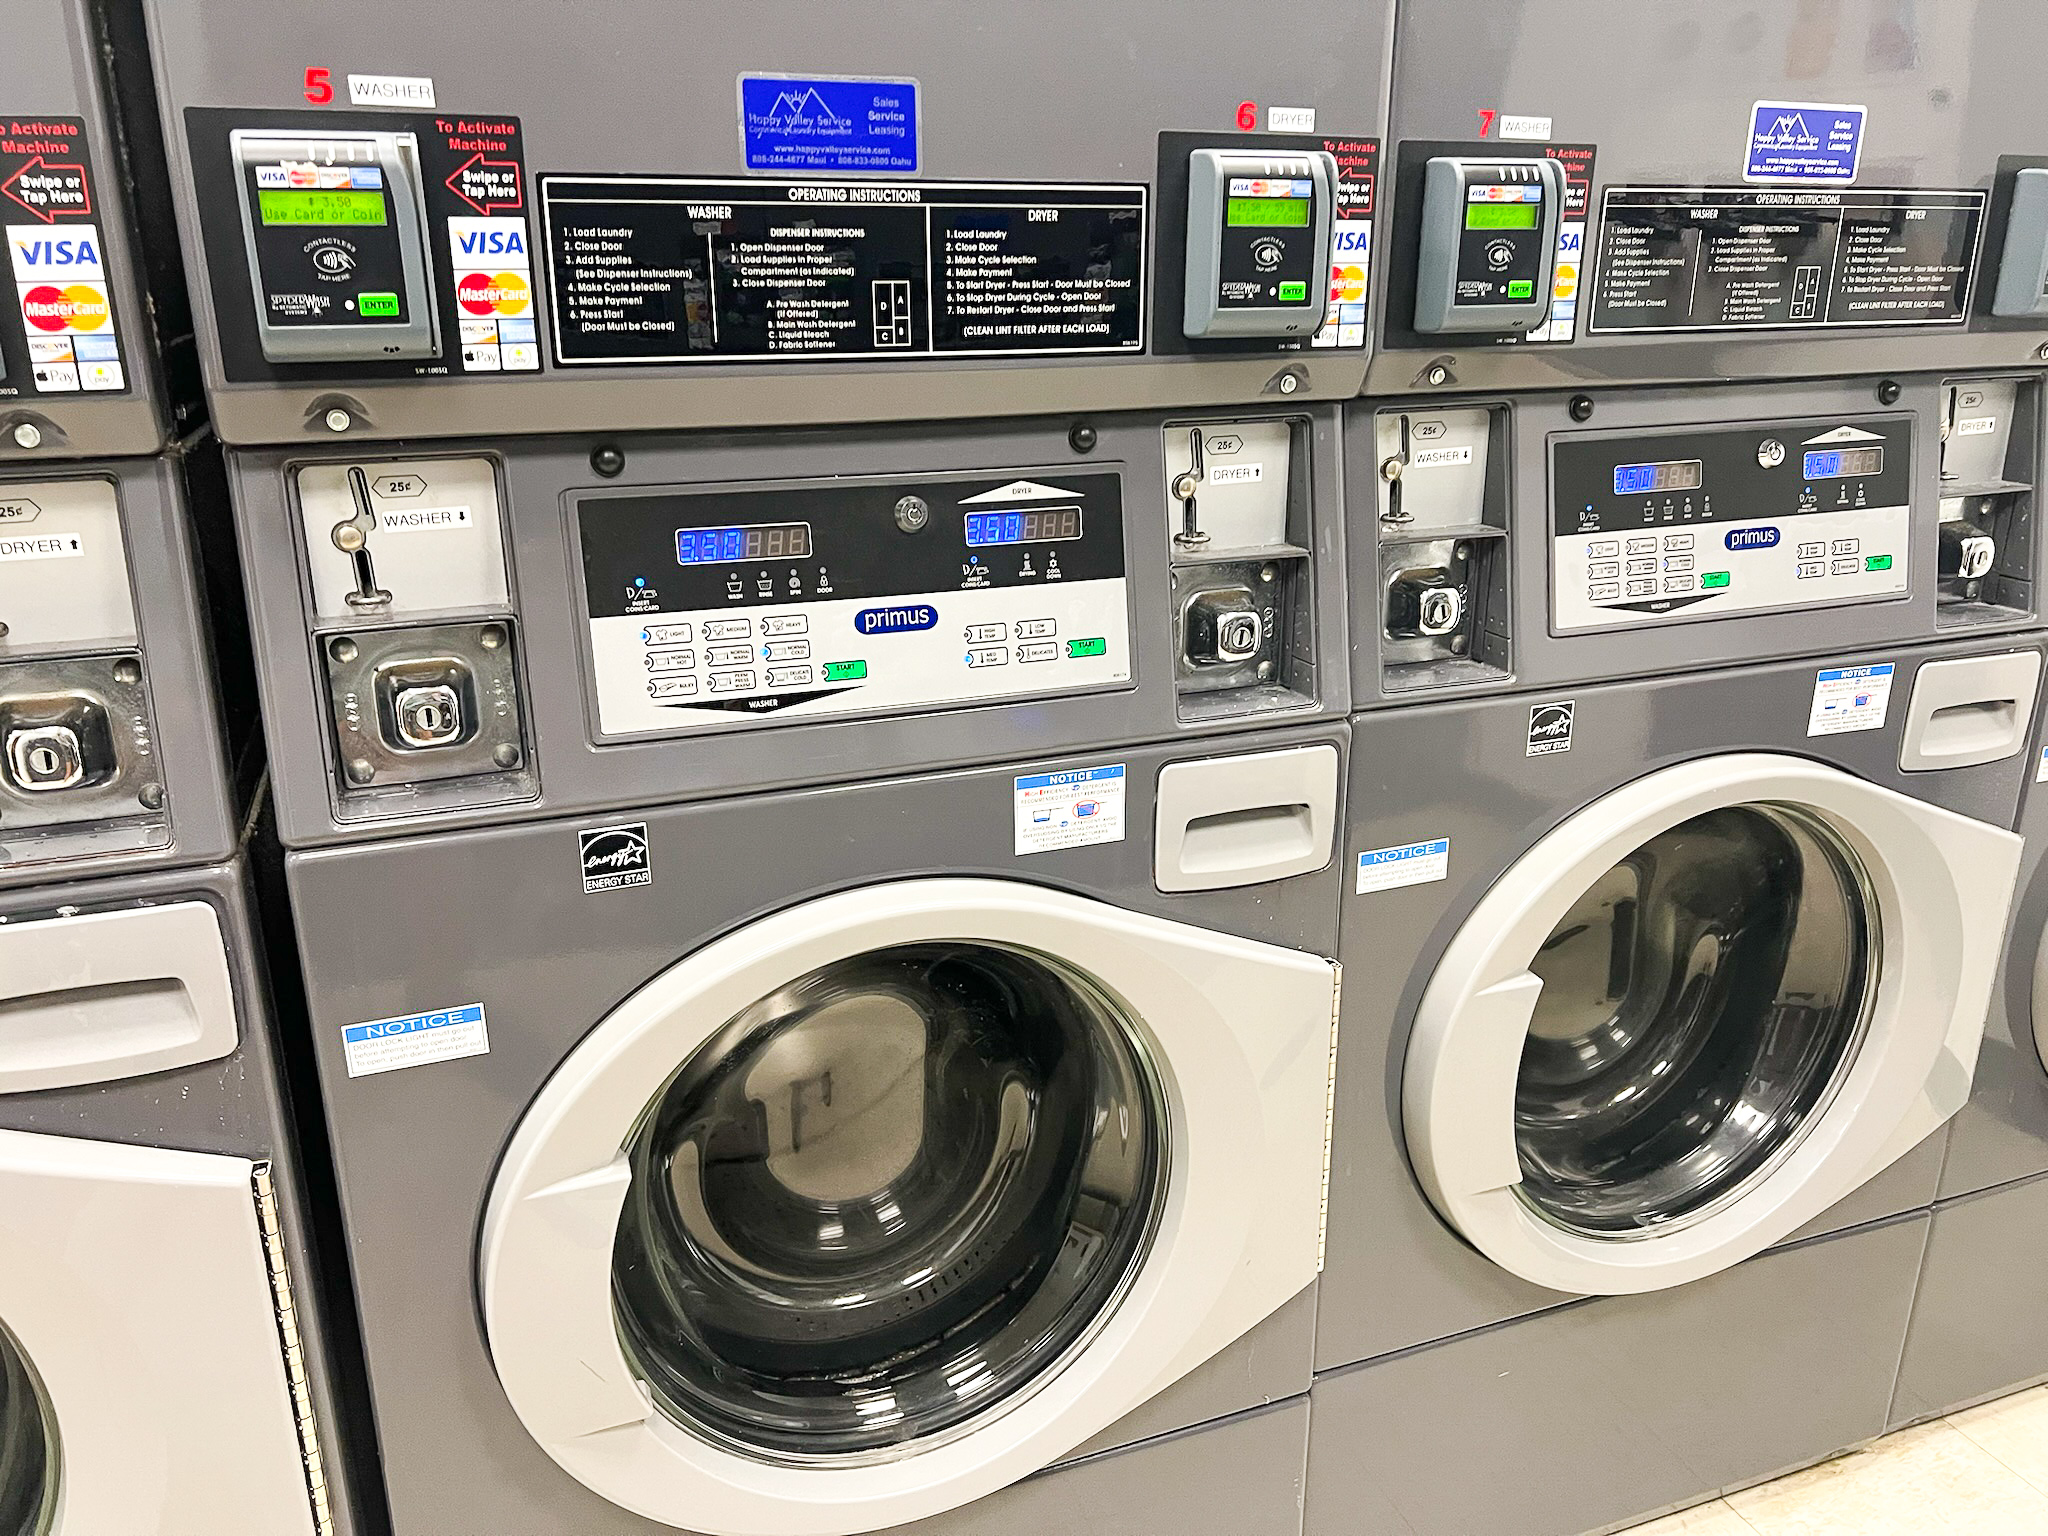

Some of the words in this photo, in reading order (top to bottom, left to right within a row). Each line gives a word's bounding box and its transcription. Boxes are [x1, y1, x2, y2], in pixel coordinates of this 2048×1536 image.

[304, 66, 335, 106] 5
[354, 82, 431, 99] WASHER
[872, 96, 900, 108] Sales
[868, 110, 905, 122] Service
[1236, 100, 1259, 132] 6
[1272, 113, 1313, 125] DRYER
[11, 122, 79, 136] Activate
[435, 120, 453, 133] To
[457, 121, 516, 134] Activate
[1478, 109, 1497, 138] 7
[1504, 121, 1550, 133] WASHER
[868, 124, 906, 137] Leasing
[1, 140, 70, 154] Machine
[448, 138, 507, 151] Machine
[1323, 141, 1336, 151] To
[1337, 142, 1377, 153] Activate
[1545, 148, 1557, 158] To
[1558, 149, 1593, 159] Activate
[19, 174, 63, 190] Swipe
[65, 177, 81, 189] or
[260, 172, 286, 181] VISA
[462, 169, 500, 186] Swipe
[501, 173, 515, 184] or
[462, 184, 486, 199] Tap
[487, 184, 517, 198] Here
[1359, 183, 1370, 192] or
[19, 190, 47, 206] Tap
[49, 190, 84, 203] Here
[788, 188, 847, 200] OPERATING
[850, 188, 921, 202] INSTRUCTIONS
[1350, 193, 1370, 204] Here
[1756, 194, 1793, 205] OPERATING
[1794, 195, 1840, 204] INSTRUCTIONS
[265, 209, 288, 220] Use
[294, 209, 325, 220] Card
[332, 211, 345, 221] or
[352, 209, 382, 221] Coin
[687, 206, 732, 219] WASHER
[1028, 210, 1058, 221] DRYER
[1690, 209, 1718, 219] WASHER
[1906, 210, 1926, 220] DRYER
[573, 228, 596, 237] Load
[597, 228, 633, 239] Laundry
[770, 228, 810, 237] DISPENSER
[812, 228, 865, 238] INSTRUCTIONS
[954, 230, 974, 238] Load
[975, 230, 1007, 240] Laundry
[303, 237, 357, 253] CONTACTLESS
[454, 230, 524, 254] VISA
[574, 241, 600, 250] Close
[601, 242, 623, 250] Door
[955, 243, 977, 251] Close
[978, 243, 998, 251] Door
[15, 241, 98, 265] VISA
[576, 255, 594, 264] Add
[595, 255, 632, 266] Supplies
[955, 256, 976, 264] Make
[978, 256, 1001, 266] Cycle
[1002, 255, 1037, 264] Selection
[317, 273, 332, 281] TAP
[333, 273, 351, 282] HERE
[575, 269, 596, 279] (See
[597, 269, 639, 279] Dispenser
[640, 269, 693, 279] Instructions)
[955, 269, 978, 277] Make
[979, 268, 1012, 278] Payment
[578, 283, 602, 292] Make
[603, 283, 629, 293] Cycle
[631, 282, 671, 292] Selection
[459, 288, 528, 302] MasterCard
[364, 301, 395, 309] ENTER
[579, 296, 603, 305] Make
[605, 296, 643, 307] Payment
[25, 301, 105, 317] MasterCard
[580, 310, 602, 319] Press
[603, 310, 624, 319] Start
[581, 322, 606, 332] (Door
[607, 322, 628, 331] Must
[629, 321, 641, 331] be
[642, 321, 675, 331] Closed)
[963, 326, 993, 337] (CLEAN
[995, 327, 1012, 336] LINT
[1013, 326, 1037, 336] FILTER
[1038, 326, 1061, 335] AFTER
[1062, 325, 1084, 335] EACH
[1085, 324, 1110, 335] LOAD)
[477, 350, 497, 365] Pay
[50, 369, 75, 385] Pay
[1961, 421, 1987, 431] DRYER
[1416, 451, 1459, 463] WASHER
[1213, 468, 1251, 480] DRYER
[389, 482, 412, 493] 25¢
[1012, 487, 1033, 496] DRYER
[384, 512, 451, 528] WASHER
[1731, 529, 1775, 547] primus
[1, 539, 62, 555] DRYER
[863, 608, 930, 632] primus
[836, 663, 855, 671] START
[1841, 668, 1872, 679] NOTICE
[749, 699, 778, 709] WASHER
[1049, 771, 1093, 785] NOTICE
[1373, 843, 1437, 864] NOTICE
[586, 875, 623, 890] ENERGY
[624, 872, 649, 884] STAR
[366, 1011, 465, 1039] NOTICE
